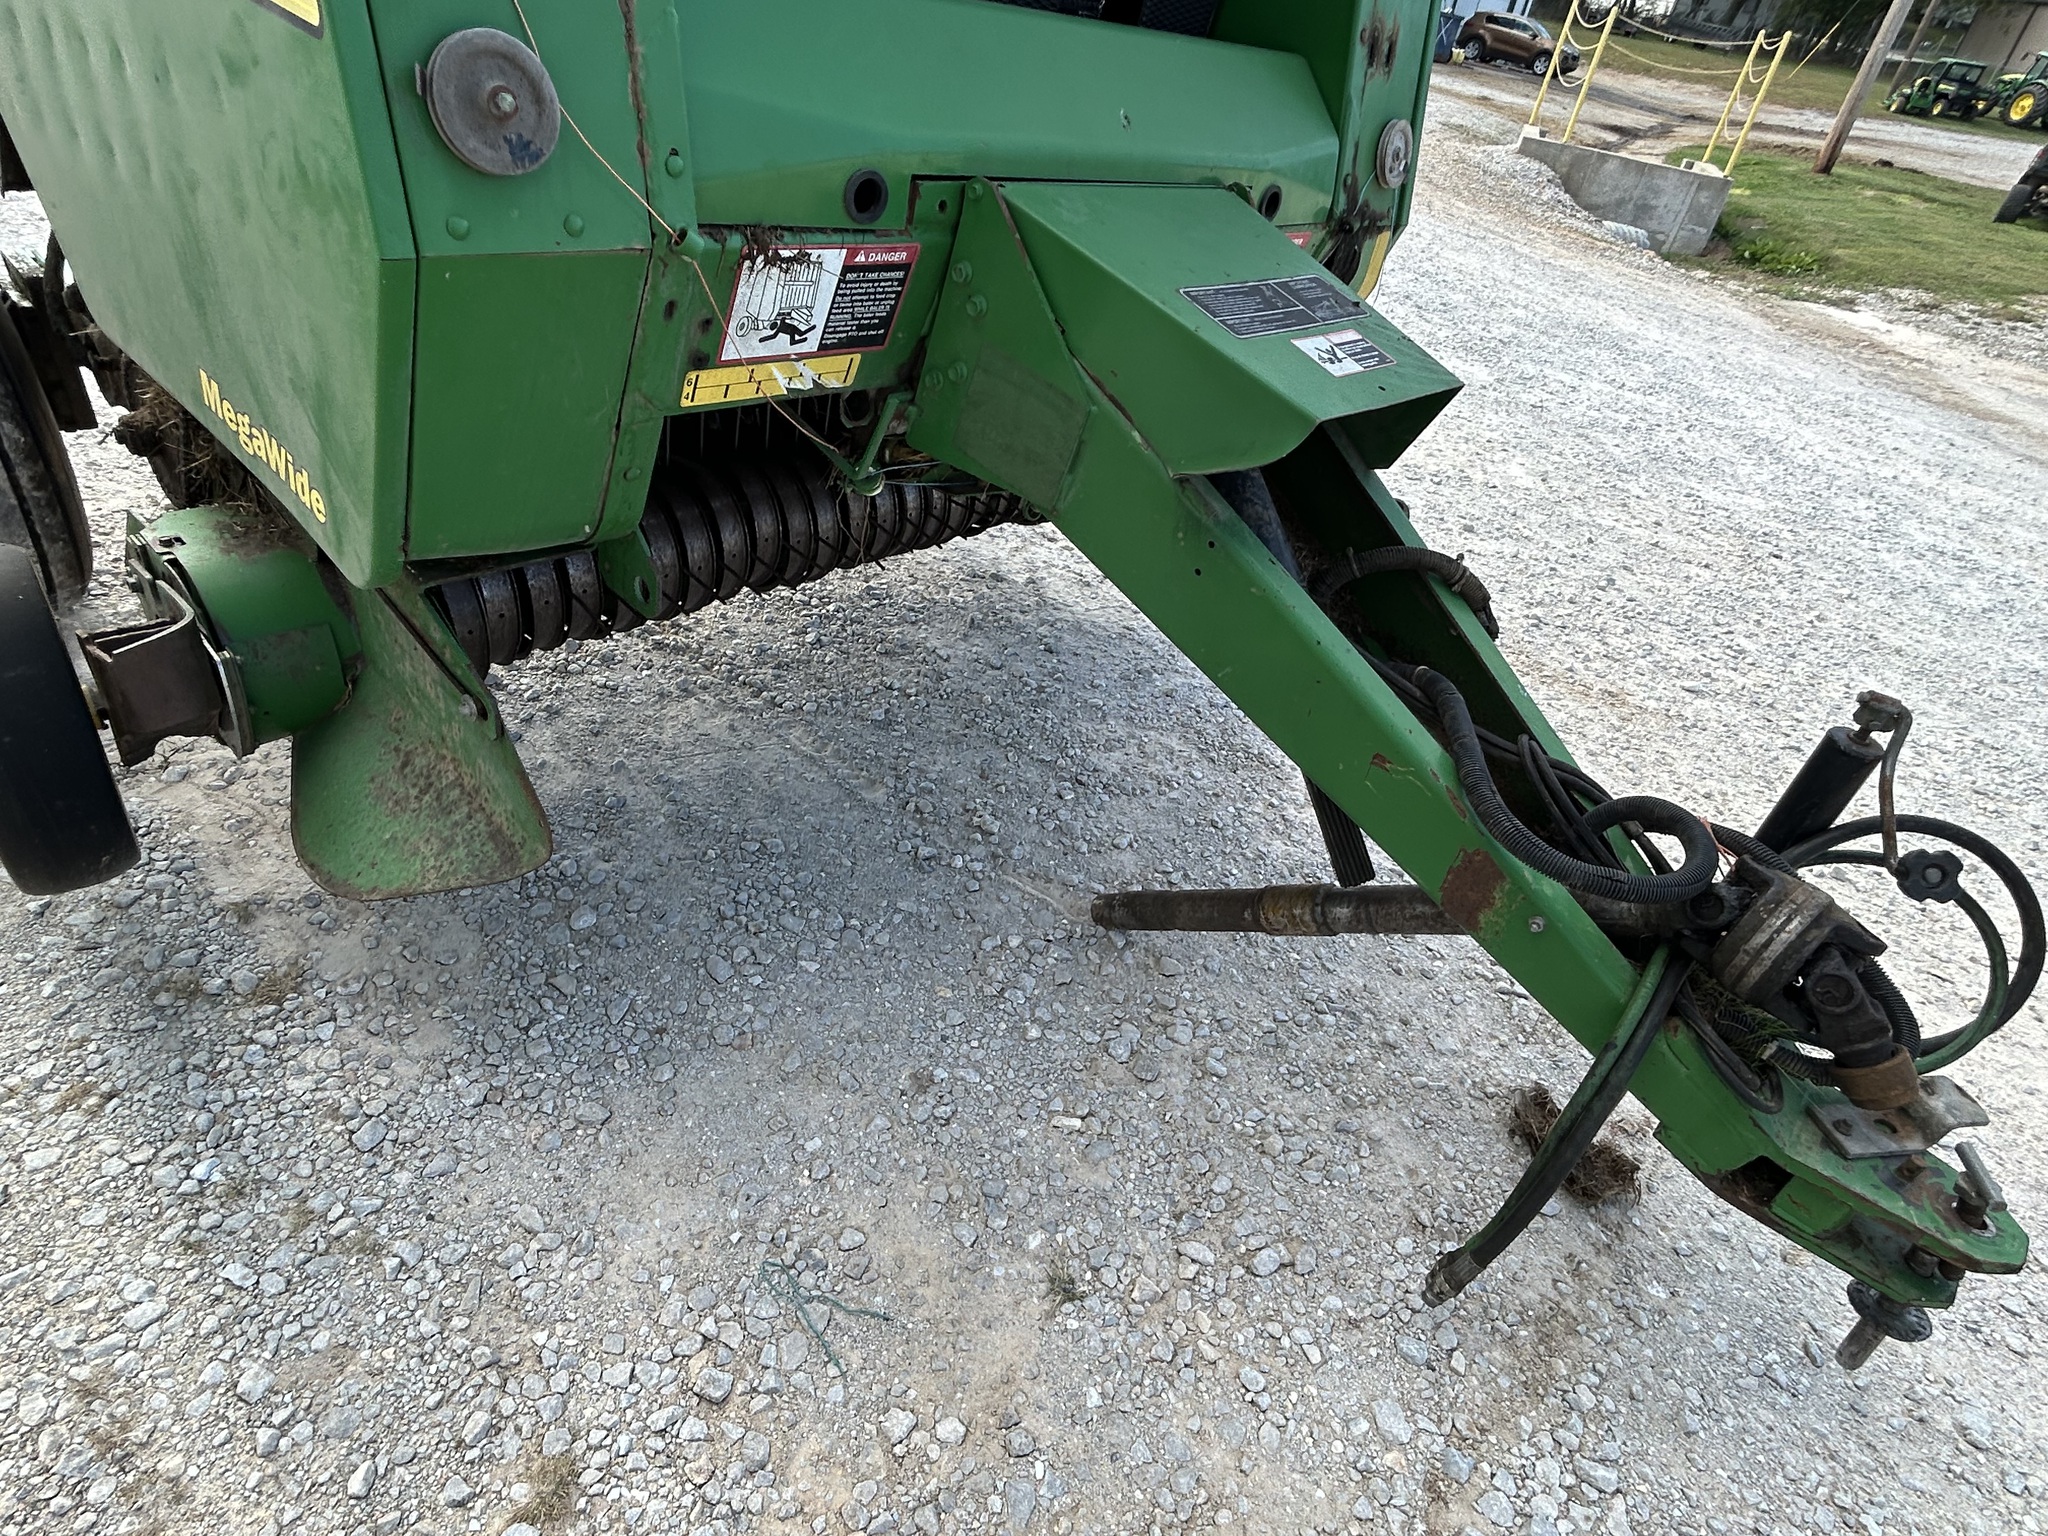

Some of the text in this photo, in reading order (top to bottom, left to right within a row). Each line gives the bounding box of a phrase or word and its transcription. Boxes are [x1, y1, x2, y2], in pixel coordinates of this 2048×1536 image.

[868, 252, 907, 262] DANGER
[687, 378, 693, 386] 6
[684, 392, 689, 400] 4
[199, 368, 327, 525] MegaWide
